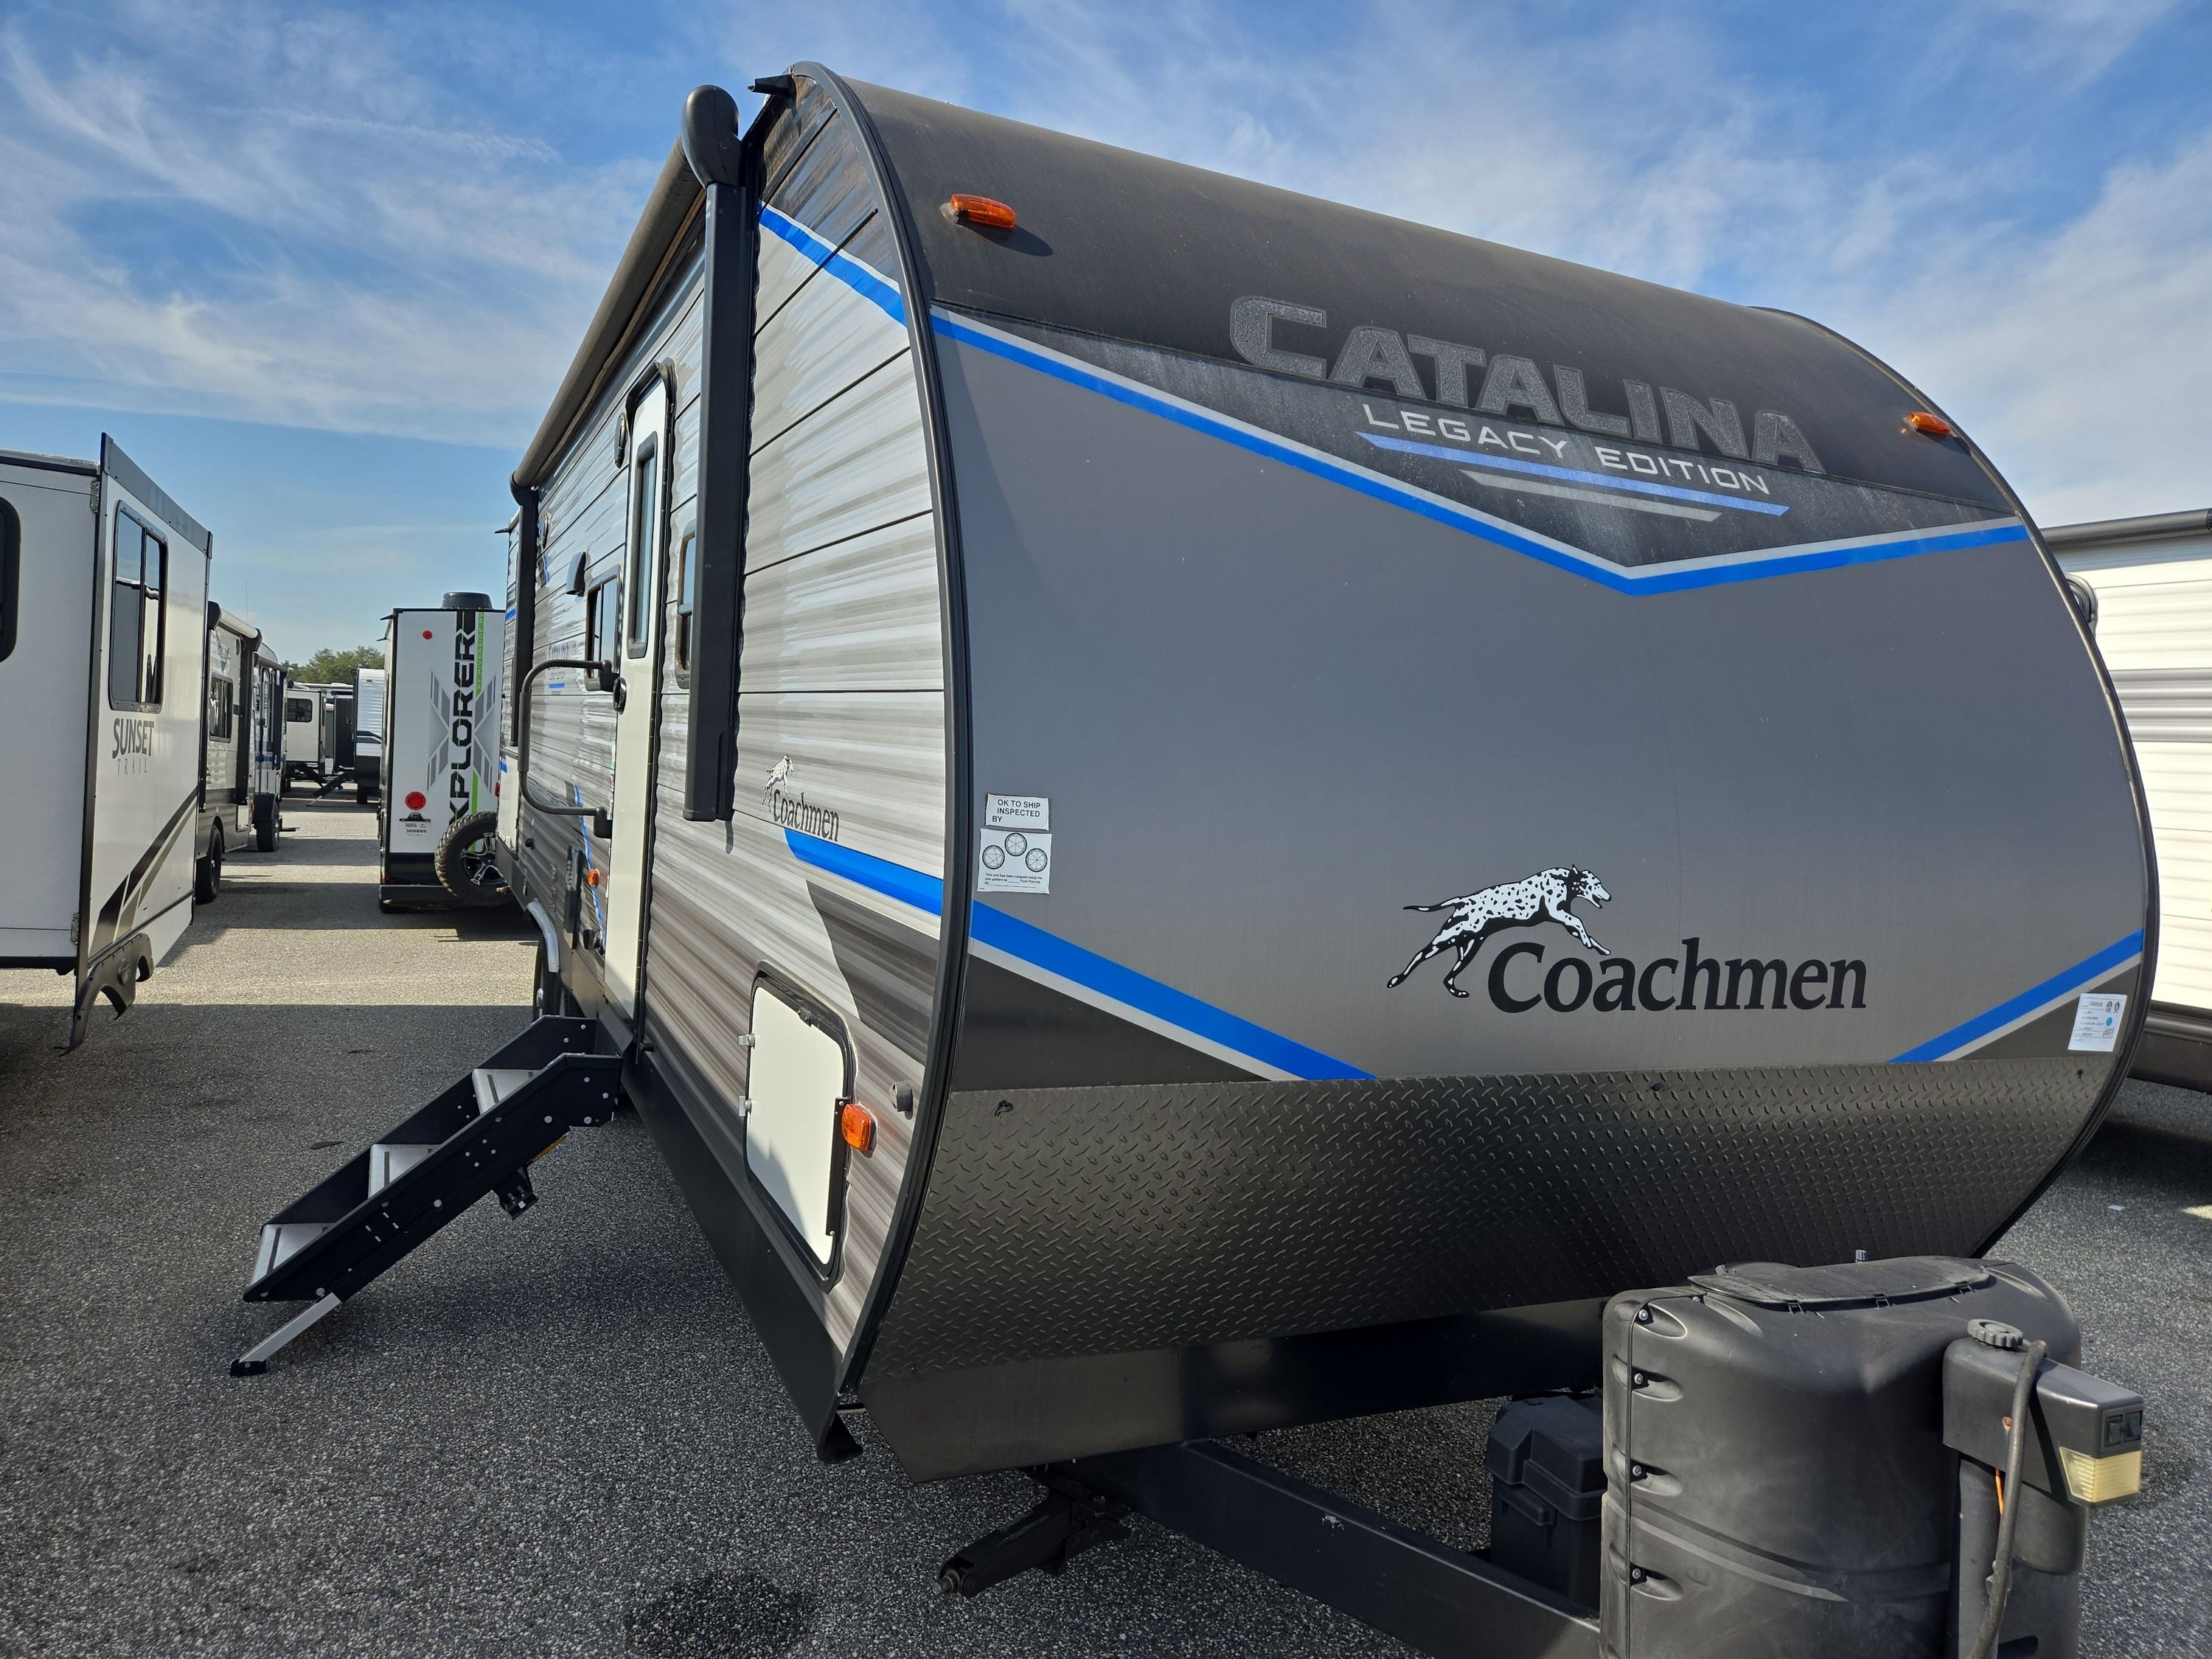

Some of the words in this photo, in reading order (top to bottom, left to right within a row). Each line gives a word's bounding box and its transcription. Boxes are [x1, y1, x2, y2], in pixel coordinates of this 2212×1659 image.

[1231, 296, 1826, 474] CATALINA
[1361, 403, 1568, 459] LEGACY
[1595, 447, 1773, 495] EDITION
[112, 717, 155, 759] SUNSET
[117, 757, 147, 776] TRAIL
[773, 788, 839, 842] Coachmen
[997, 799, 1009, 807] OK
[997, 807, 1040, 818] INSPECTED
[1487, 937, 1867, 1013] Coachmen
